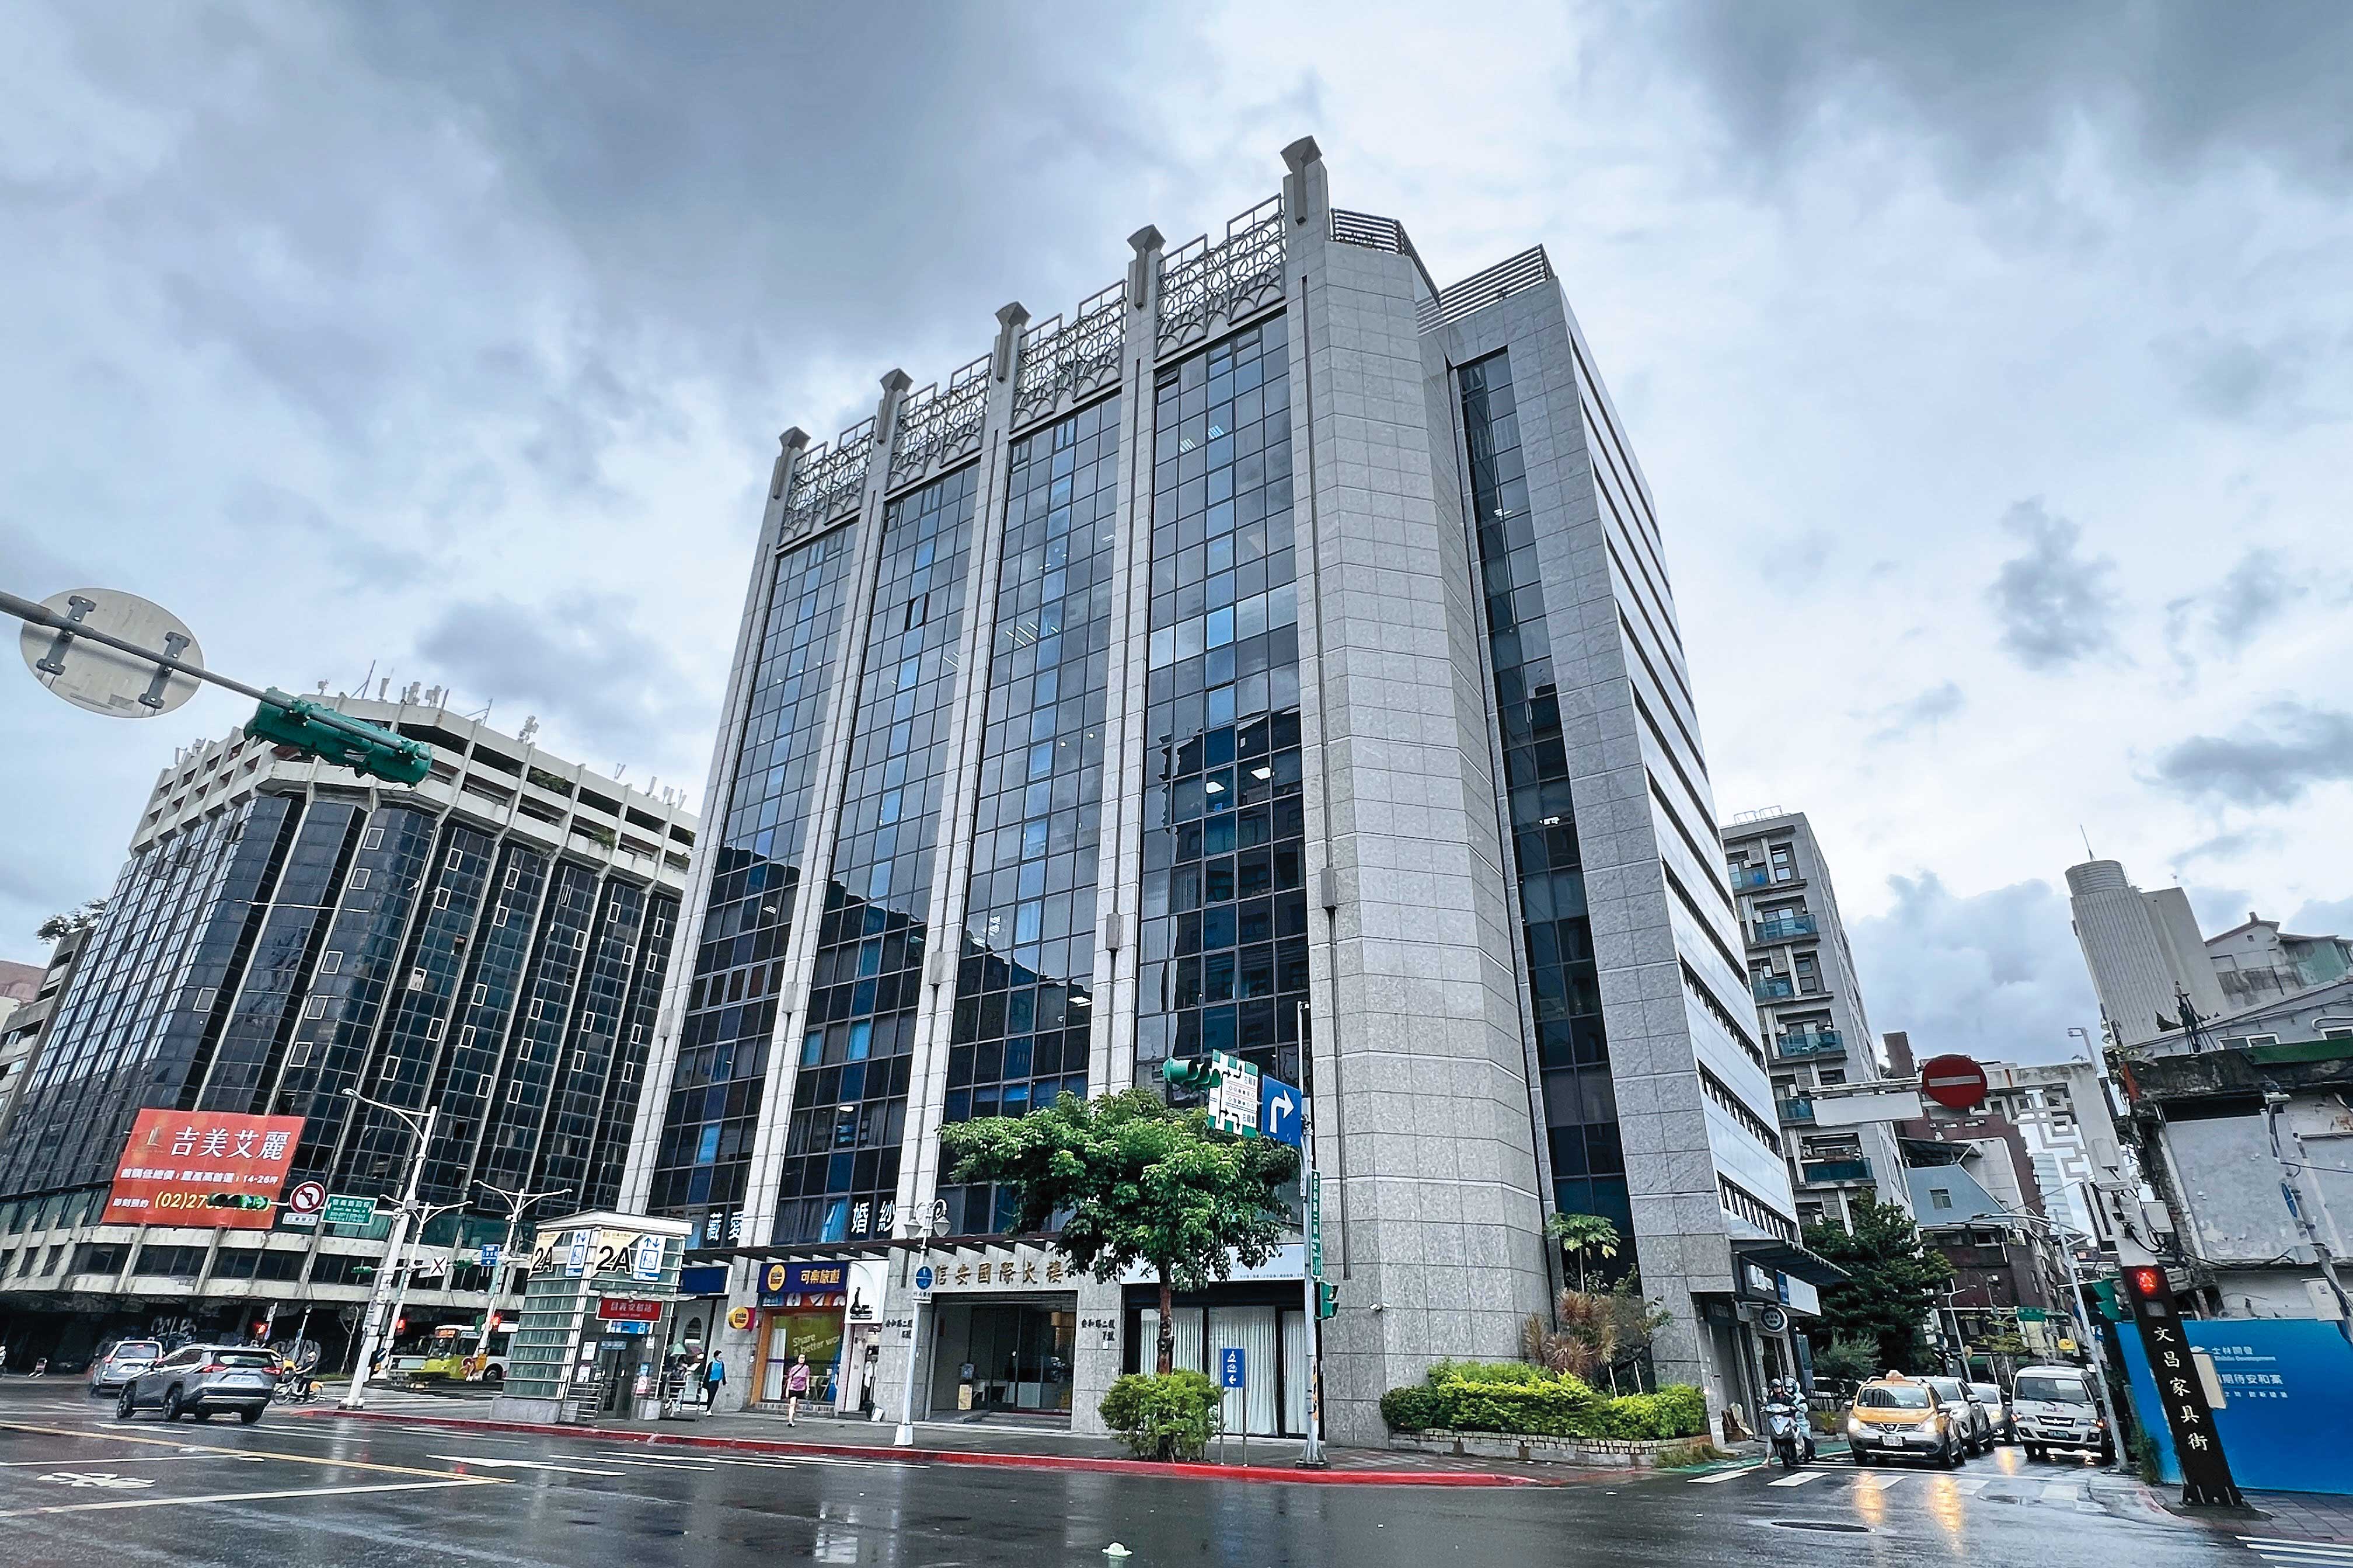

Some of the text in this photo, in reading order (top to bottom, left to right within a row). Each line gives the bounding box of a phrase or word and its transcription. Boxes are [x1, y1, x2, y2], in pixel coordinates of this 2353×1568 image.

[171, 1126, 291, 1161] 吉美艾麗
[851, 1200, 897, 1234] 婚紗
[532, 1246, 553, 1272] 2A
[596, 1246, 630, 1273] 2A
[935, 1260, 1064, 1285] 信安國際大樓
[793, 1333, 815, 1347] Share
[800, 1340, 824, 1353] better
[2154, 1326, 2208, 1452] 文昌家具街
